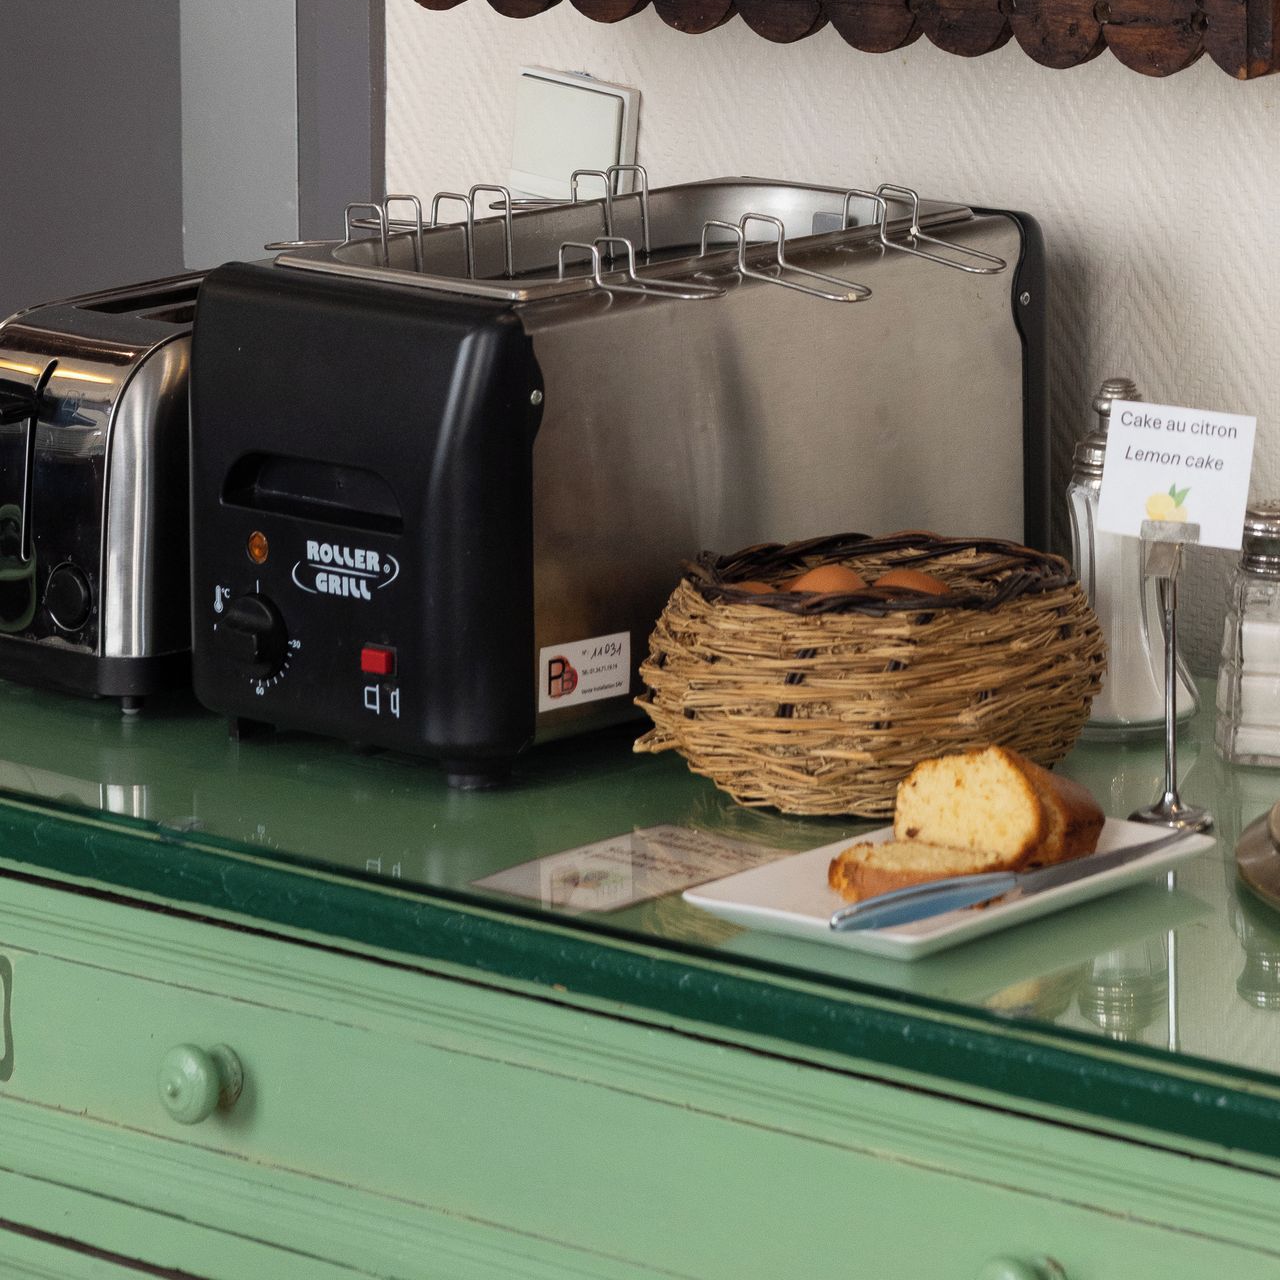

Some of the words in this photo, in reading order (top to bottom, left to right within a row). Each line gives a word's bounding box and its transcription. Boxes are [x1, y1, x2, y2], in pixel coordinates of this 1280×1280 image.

[1120, 410, 1162, 430] Cake
[1166, 419, 1186, 433] au
[1190, 420, 1238, 439] citron
[1125, 445, 1181, 466] Lemon
[1185, 454, 1224, 471] cake
[306, 540, 380, 572] ROLLER
[315, 572, 372, 601] GRILL
